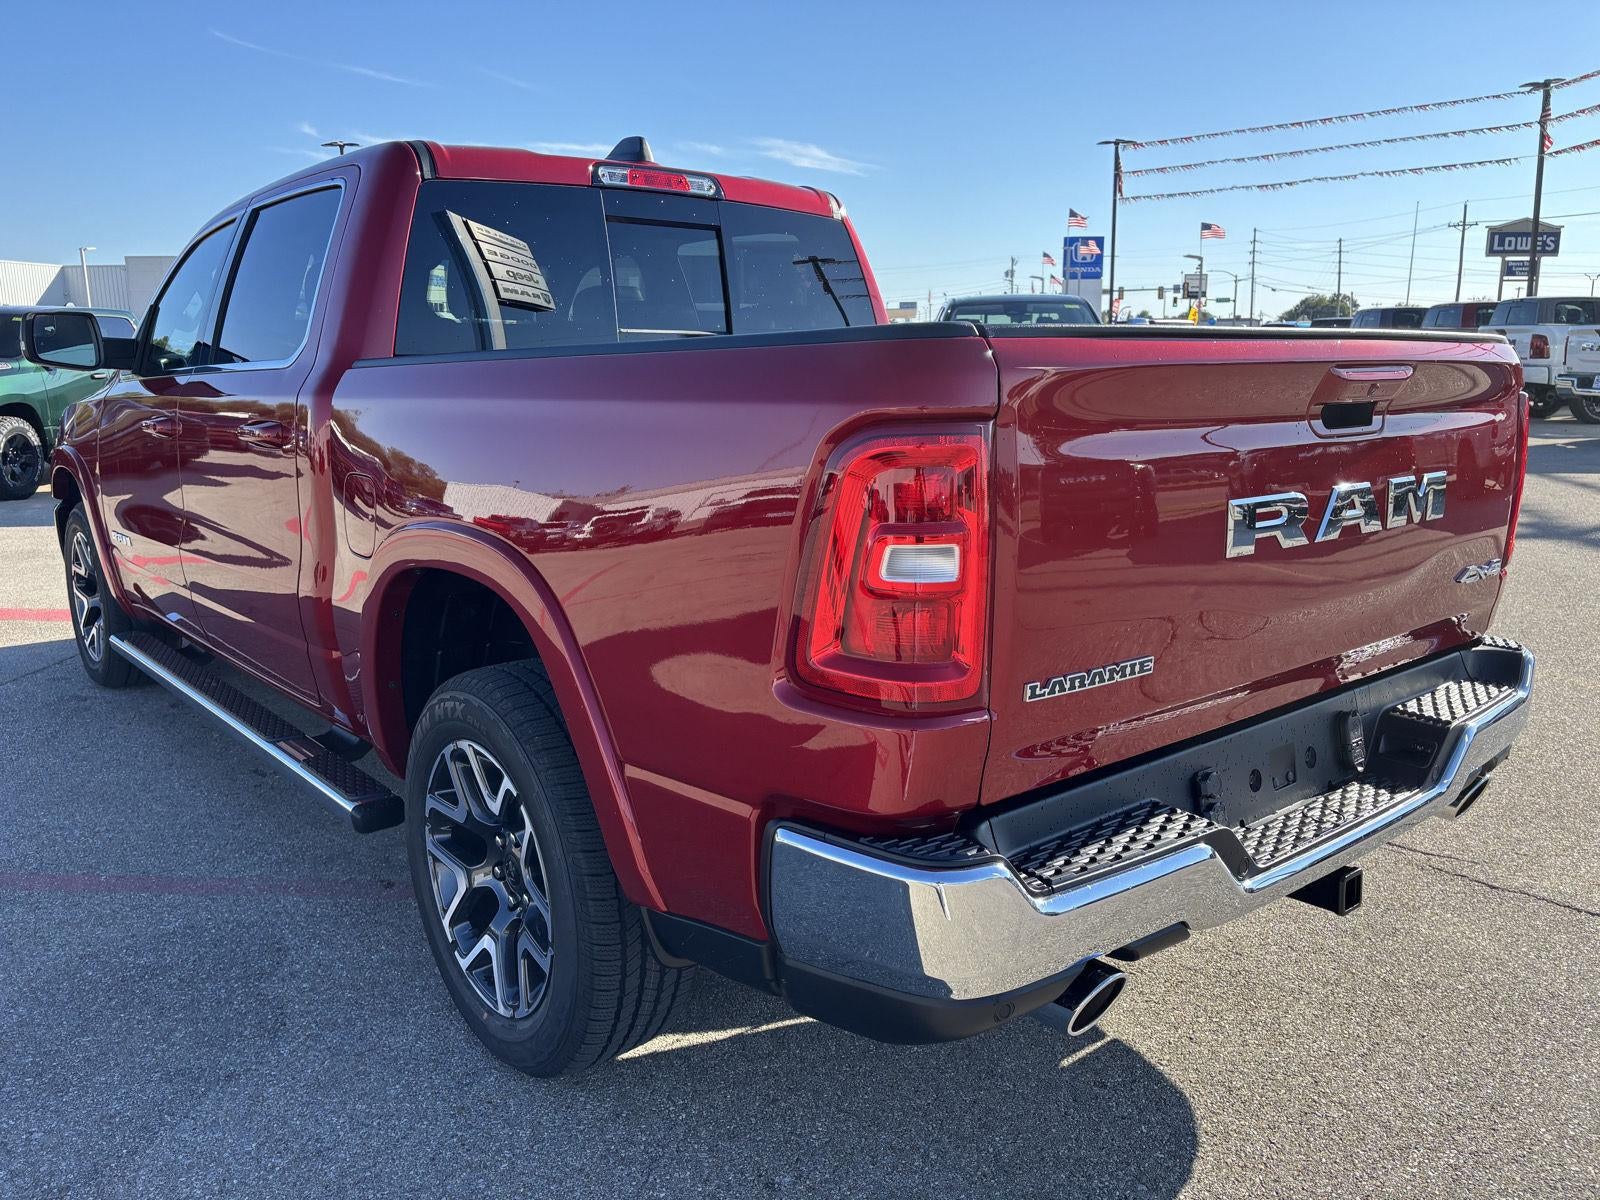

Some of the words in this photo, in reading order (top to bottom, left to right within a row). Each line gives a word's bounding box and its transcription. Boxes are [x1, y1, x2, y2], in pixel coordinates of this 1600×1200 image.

[1493, 234, 1556, 251] LOWE'S
[1225, 470, 1448, 559] RAM
[1023, 656, 1155, 703] LARAMIE
